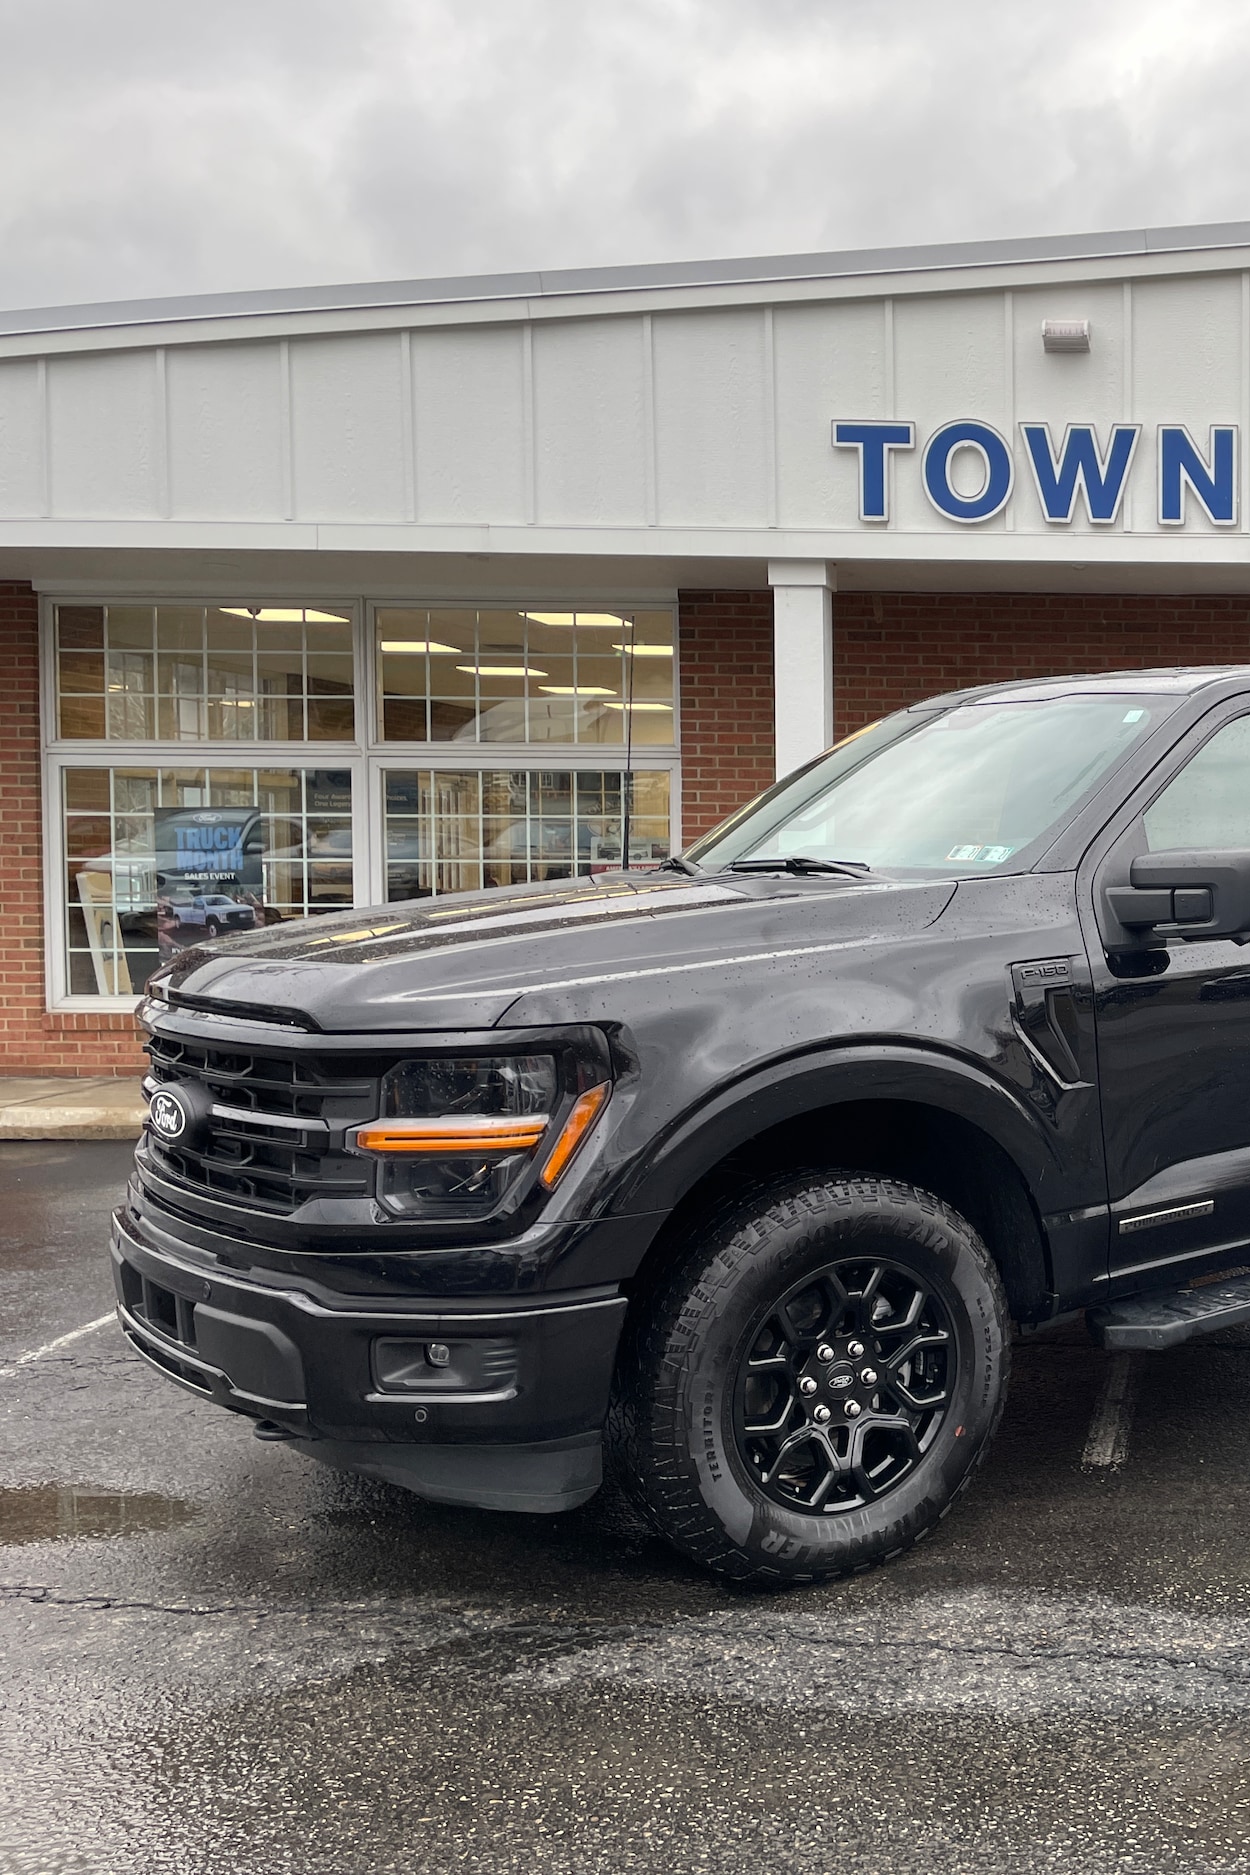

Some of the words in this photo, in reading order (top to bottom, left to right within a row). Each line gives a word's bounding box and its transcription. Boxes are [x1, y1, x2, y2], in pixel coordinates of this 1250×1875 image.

[832, 419, 1239, 526] TOWN
[174, 827, 242, 849] TRUCK
[176, 850, 244, 870] MONTH
[155, 1096, 178, 1132] Ford
[703, 1381, 722, 1482] TERRITORY
